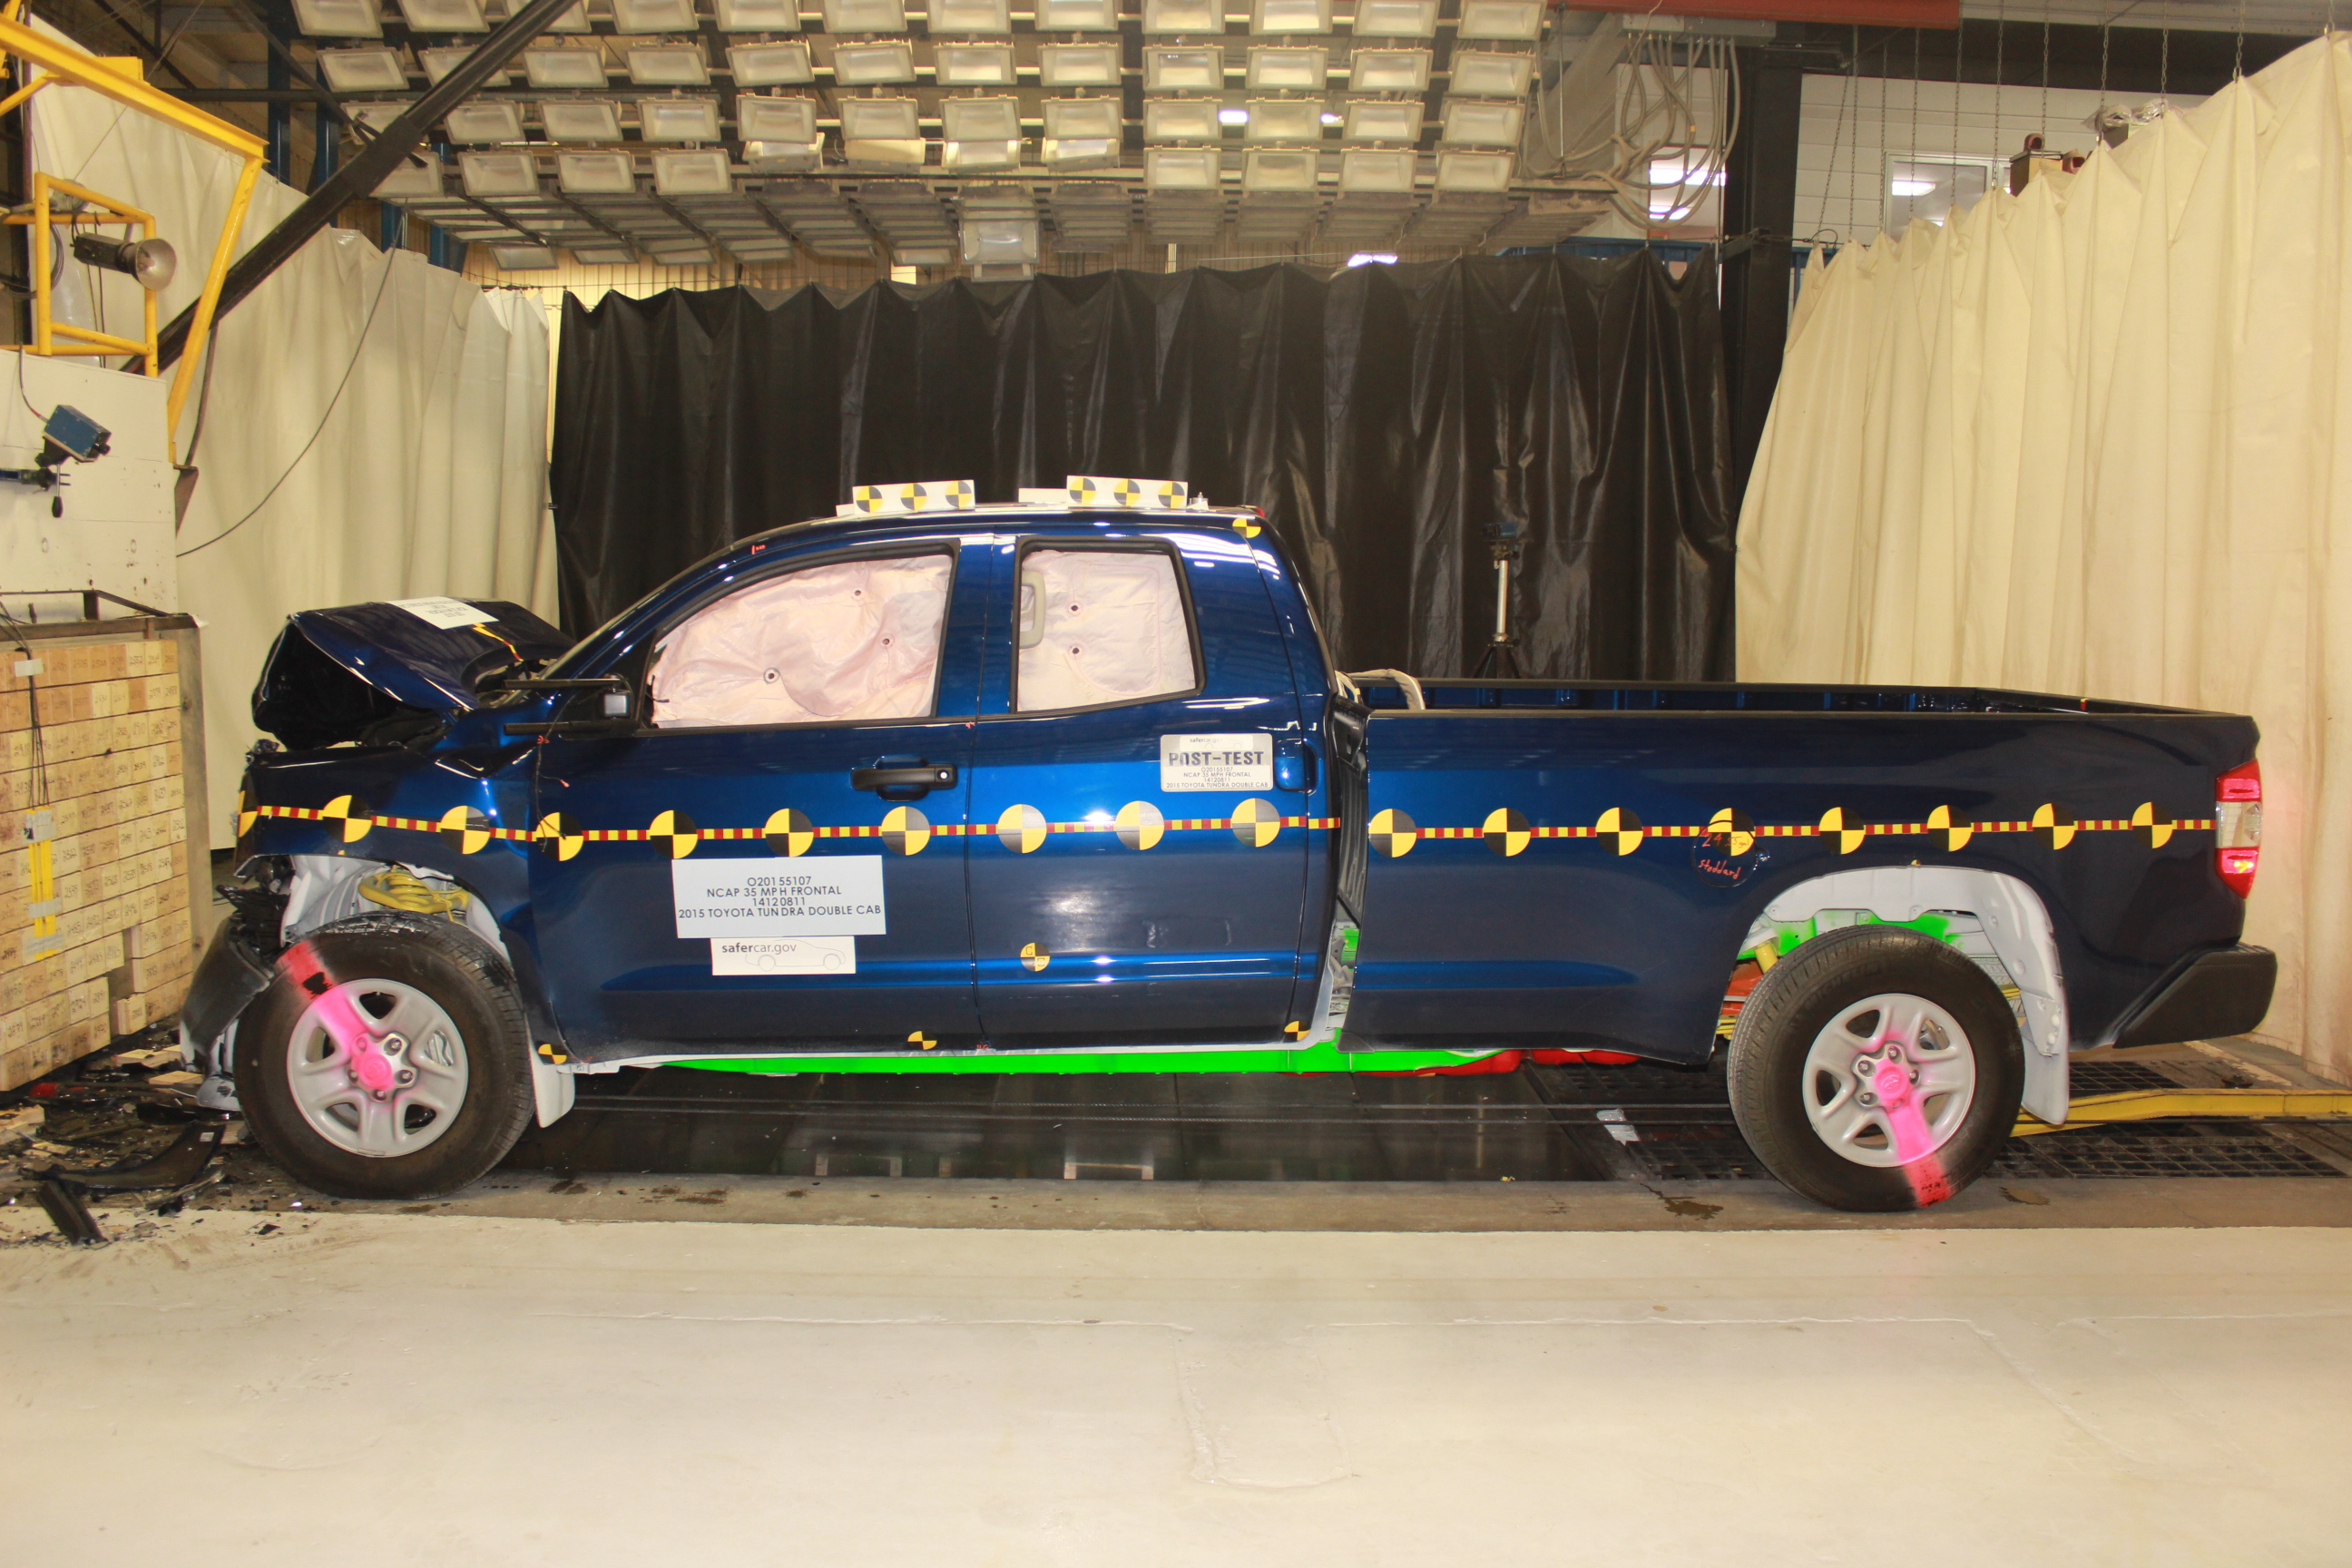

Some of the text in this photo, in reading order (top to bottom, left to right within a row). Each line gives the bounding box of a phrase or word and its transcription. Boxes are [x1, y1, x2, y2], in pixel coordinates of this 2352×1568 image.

[1169, 751, 1264, 766] POST-TEST
[707, 886, 842, 897] NCAP 35 MPH FRONTAL
[752, 897, 806, 906] 14120811
[679, 905, 881, 918] 2015 TOYOTA TUNDRA DOUBLE CAB
[721, 942, 797, 955] safercar.gov
